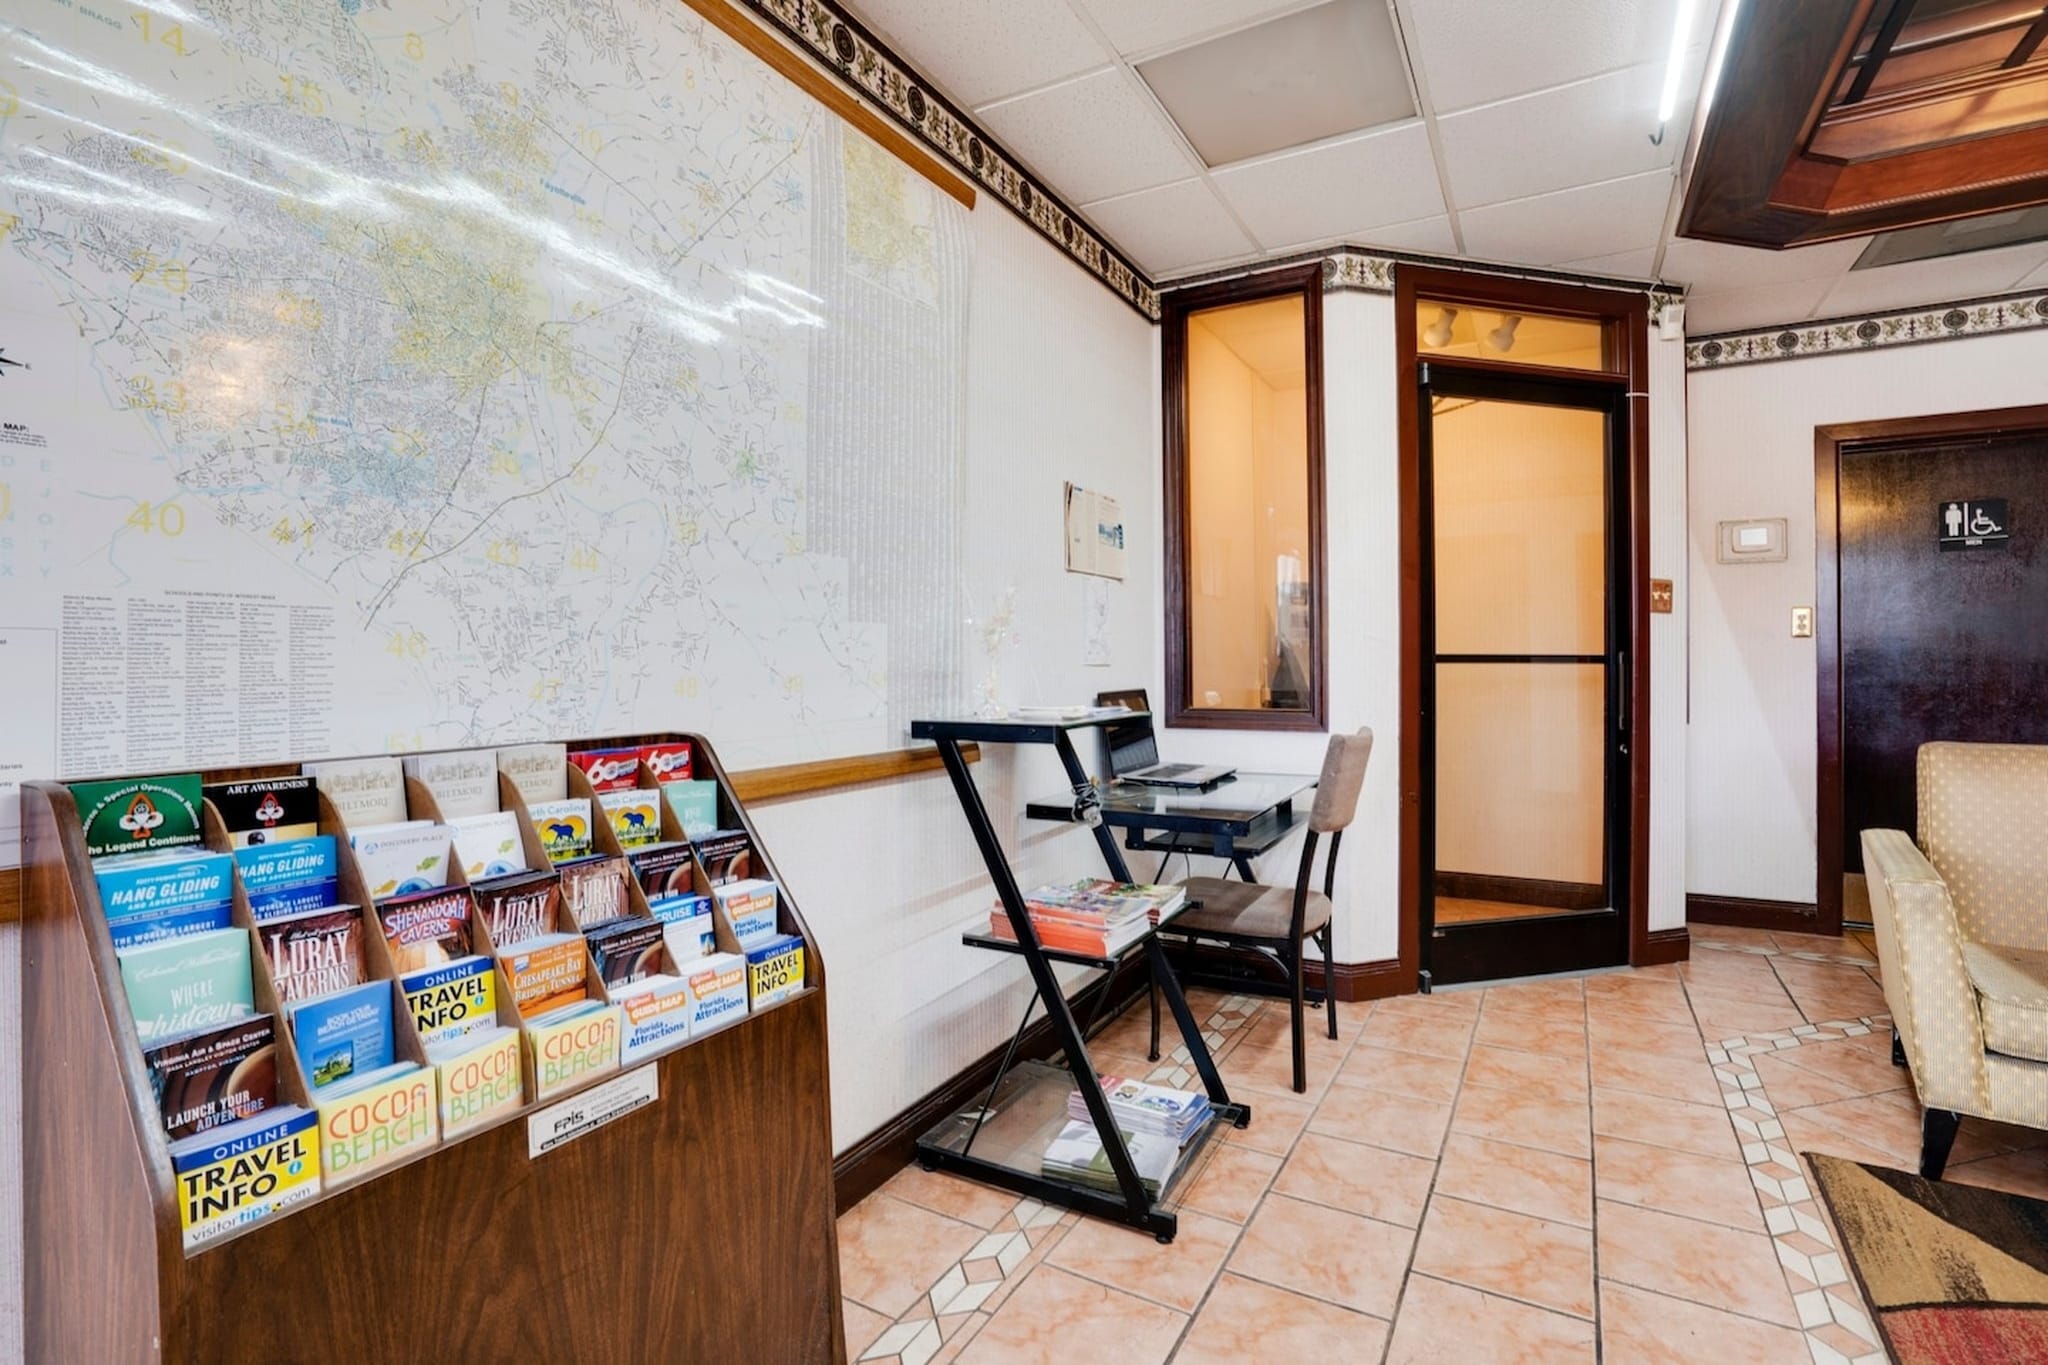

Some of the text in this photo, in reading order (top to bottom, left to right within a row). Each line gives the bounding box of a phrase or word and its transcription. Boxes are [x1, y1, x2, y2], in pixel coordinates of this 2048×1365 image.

[131, 11, 187, 57] 14
[404, 31, 426, 62] 8
[129, 248, 191, 294] 28
[129, 374, 189, 416] 33
[125, 500, 187, 539] 40
[269, 515, 314, 552] 41
[385, 528, 428, 561] 42
[483, 537, 520, 568] 43
[568, 547, 600, 573] 44
[103, 784, 139, 803] Special
[227, 780, 308, 795] ART AWARENESS
[547, 803, 586, 815] Carolina
[88, 834, 200, 855] he Legend Continues
[422, 834, 444, 843] PLACE
[277, 854, 325, 873] GLIDING
[110, 885, 157, 906] HANG
[160, 875, 220, 898] GLIDING
[128, 892, 205, 911] AND ADVENTURES
[572, 872, 620, 911] LURAY
[385, 897, 466, 938] SHENANDOAH
[492, 894, 549, 935] LURAY
[736, 921, 773, 937] ttractions
[114, 920, 216, 946] THE WORLD'S LARGEST
[399, 921, 451, 945] CAVERNS
[270, 929, 350, 979] LURAY
[756, 953, 799, 979] TRAVEL
[764, 944, 793, 960] ONLINE
[424, 964, 474, 987] ONLINE
[513, 956, 582, 990] CHESAPEAKE BAY
[757, 971, 788, 995] INFO
[170, 979, 214, 1009] WHERE
[408, 978, 486, 1013] TRAVEL
[661, 993, 685, 1008] MAP
[151, 1001, 232, 1040] history
[418, 1002, 467, 1032] NFO
[695, 998, 744, 1022] Attractions
[544, 1017, 615, 1060] COCOA
[629, 1022, 685, 1048] Attractions
[635, 1021, 663, 1037] Florida
[185, 1055, 212, 1069] LANGLEY
[449, 1043, 518, 1094] COCOA
[545, 1043, 613, 1086] BEACH
[167, 1090, 251, 1131] LAUNCH YOUR
[328, 1082, 427, 1140] COCOA
[451, 1073, 519, 1124] BEACH
[196, 1098, 265, 1133] ADVENTURE
[213, 1124, 289, 1160] ONLINE
[331, 1110, 428, 1172] BEACH
[184, 1138, 307, 1198] TRAVEL
[190, 1173, 278, 1225] INFO
